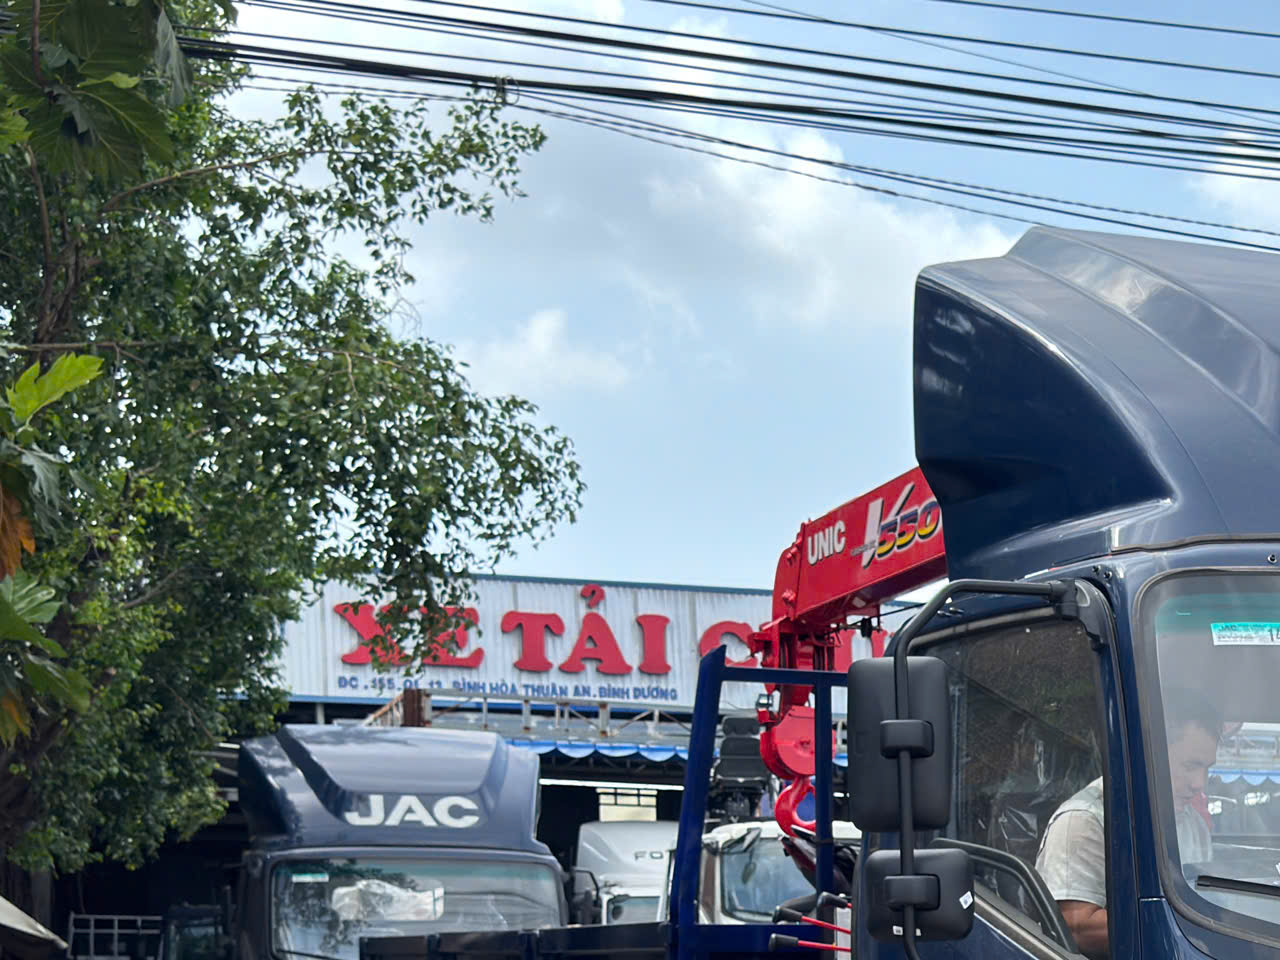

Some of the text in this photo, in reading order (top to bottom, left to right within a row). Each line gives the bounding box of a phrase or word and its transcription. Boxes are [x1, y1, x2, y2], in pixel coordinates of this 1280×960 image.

[808, 520, 845, 566] UNIC
[501, 583, 672, 675] TẢI
[344, 794, 480, 828] JAC
